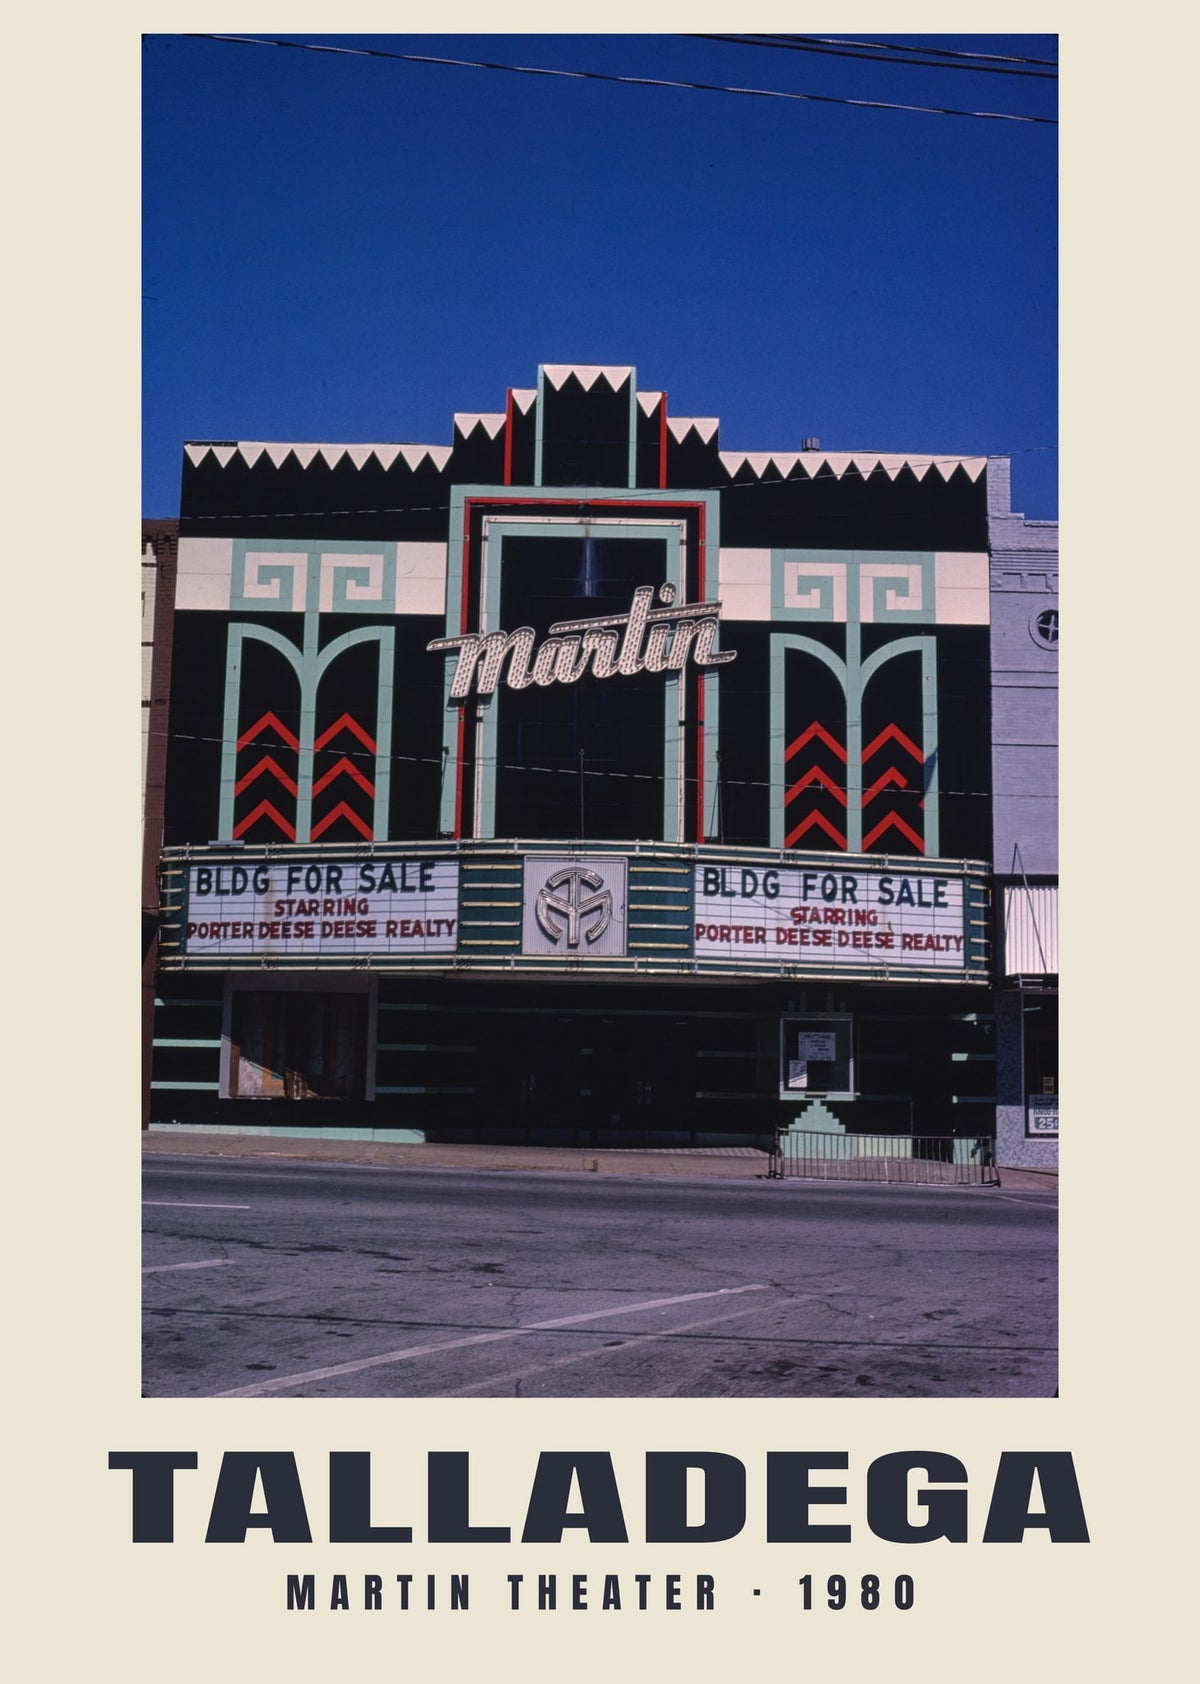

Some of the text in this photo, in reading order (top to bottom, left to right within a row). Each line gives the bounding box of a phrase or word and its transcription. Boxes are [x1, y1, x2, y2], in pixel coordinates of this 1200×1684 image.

[196, 862, 435, 896] BLDG FOR SALE
[703, 867, 949, 908] BLDG FOR SALE
[274, 898, 369, 917] STARRING
[790, 906, 878, 926] STARRING
[187, 919, 456, 940] PORTER DEESE DEESE REALTY
[695, 923, 964, 952] PORTER DEESE DEESE REALTY
